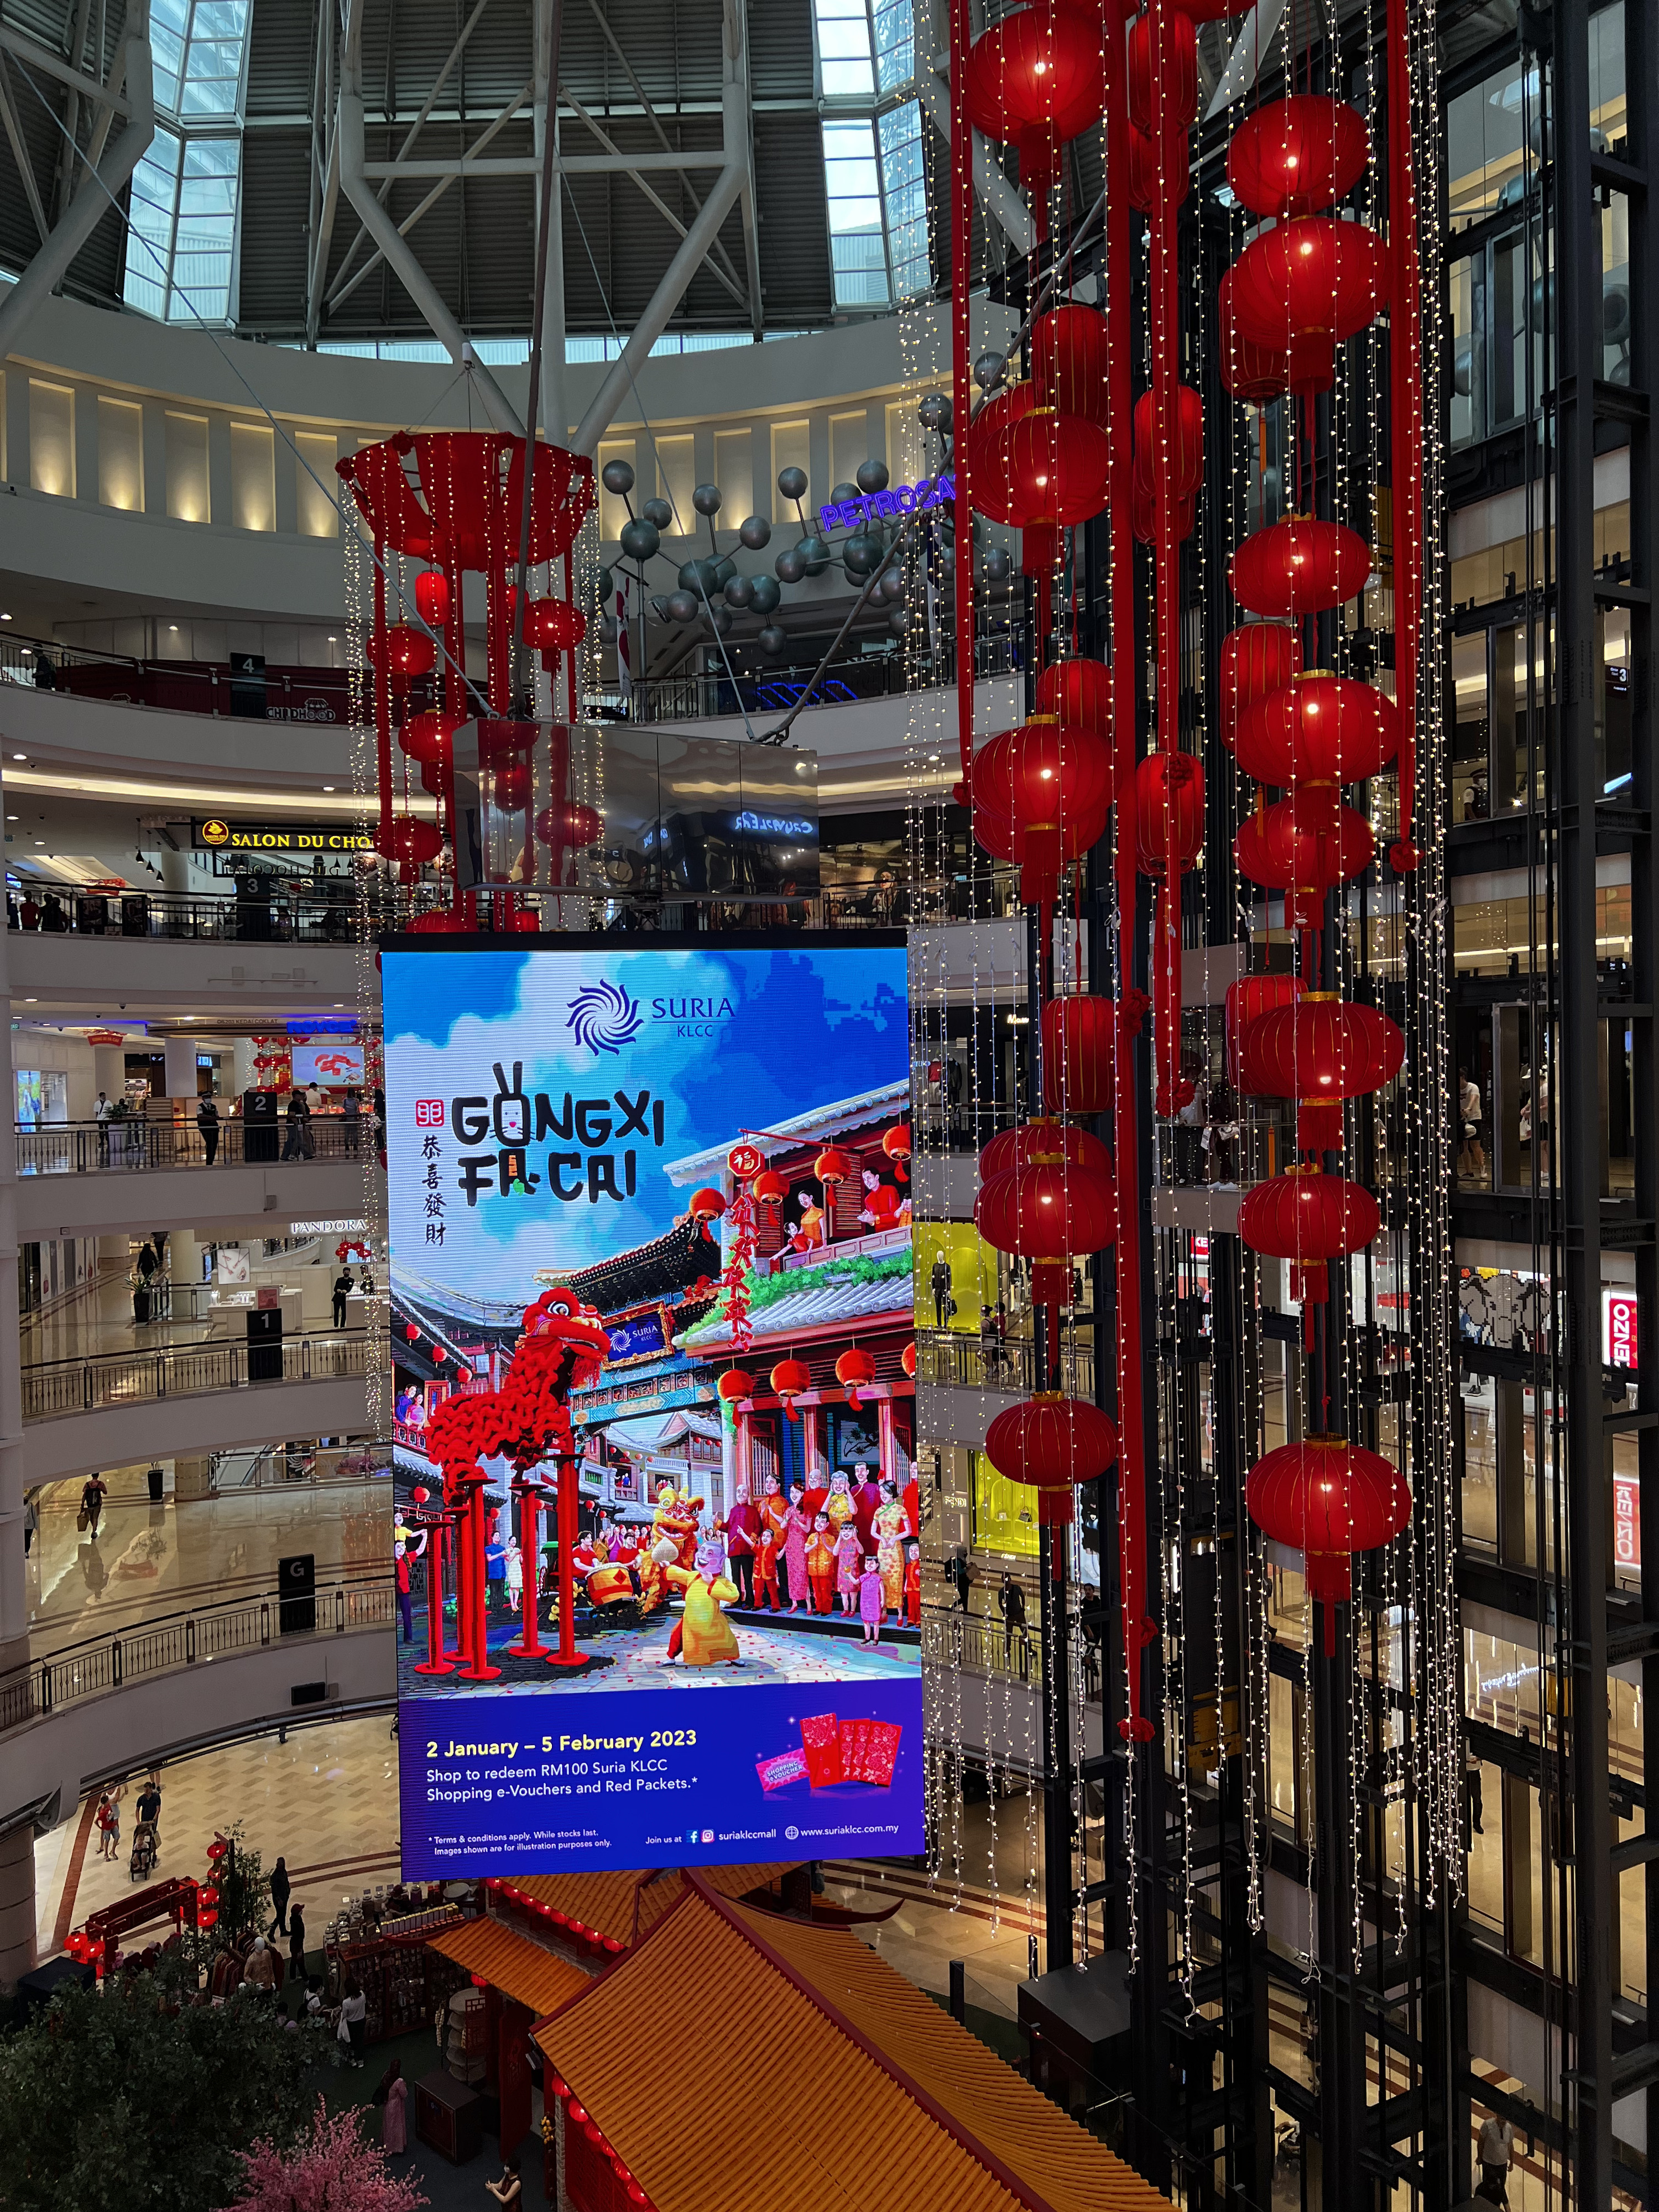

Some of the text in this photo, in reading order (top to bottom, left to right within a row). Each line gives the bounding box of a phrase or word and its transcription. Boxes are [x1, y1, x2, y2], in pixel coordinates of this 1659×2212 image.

[820, 474, 956, 533] PETROSA
[243, 658, 254, 673] 4
[1619, 669, 1626, 682] 3
[232, 833, 290, 847] SALON
[298, 835, 324, 847] DU
[328, 836, 373, 848] CHO
[247, 878, 259, 893] 3
[652, 998, 736, 1019] SURIA
[677, 1025, 713, 1037] KLCC
[255, 1096, 266, 1110] 2
[733, 1151, 754, 1170] 福
[549, 1149, 637, 1204] CAI
[421, 1135, 447, 1246] 恭喜發財
[293, 1219, 366, 1233] PANDORA
[261, 1313, 269, 1328] 1
[633, 1325, 658, 1338] SURIA
[290, 1562, 304, 1577] G
[427, 1741, 438, 1757] 2
[444, 1740, 519, 1759] January
[541, 1736, 552, 1752] 5
[560, 1734, 644, 1752] February
[650, 1729, 697, 1747] 2023
[427, 1759, 668, 1784] Shop to redeem RM100 Suria KLCC
[766, 1761, 798, 1777] SHOPPING
[427, 1787, 492, 1803] Shopping
[497, 1783, 572, 1797] e-Vouchers
[576, 1780, 601, 1793] and
[606, 1779, 632, 1792] Red
[434, 1836, 457, 1844] Terms
[467, 1834, 507, 1842] conditions
[509, 1832, 531, 1841] apply.
[534, 1830, 555, 1839] While
[557, 1829, 581, 1838] stocks
[645, 1836, 661, 1844] Join
[718, 1828, 776, 1840] suriaklccmall
[801, 1825, 899, 1836] www.suriaklcc.com.my
[434, 1848, 462, 1856] Images
[517, 1842, 556, 1850] illustration
[558, 1840, 592, 1850] purposes
[594, 1839, 612, 1848] only.
